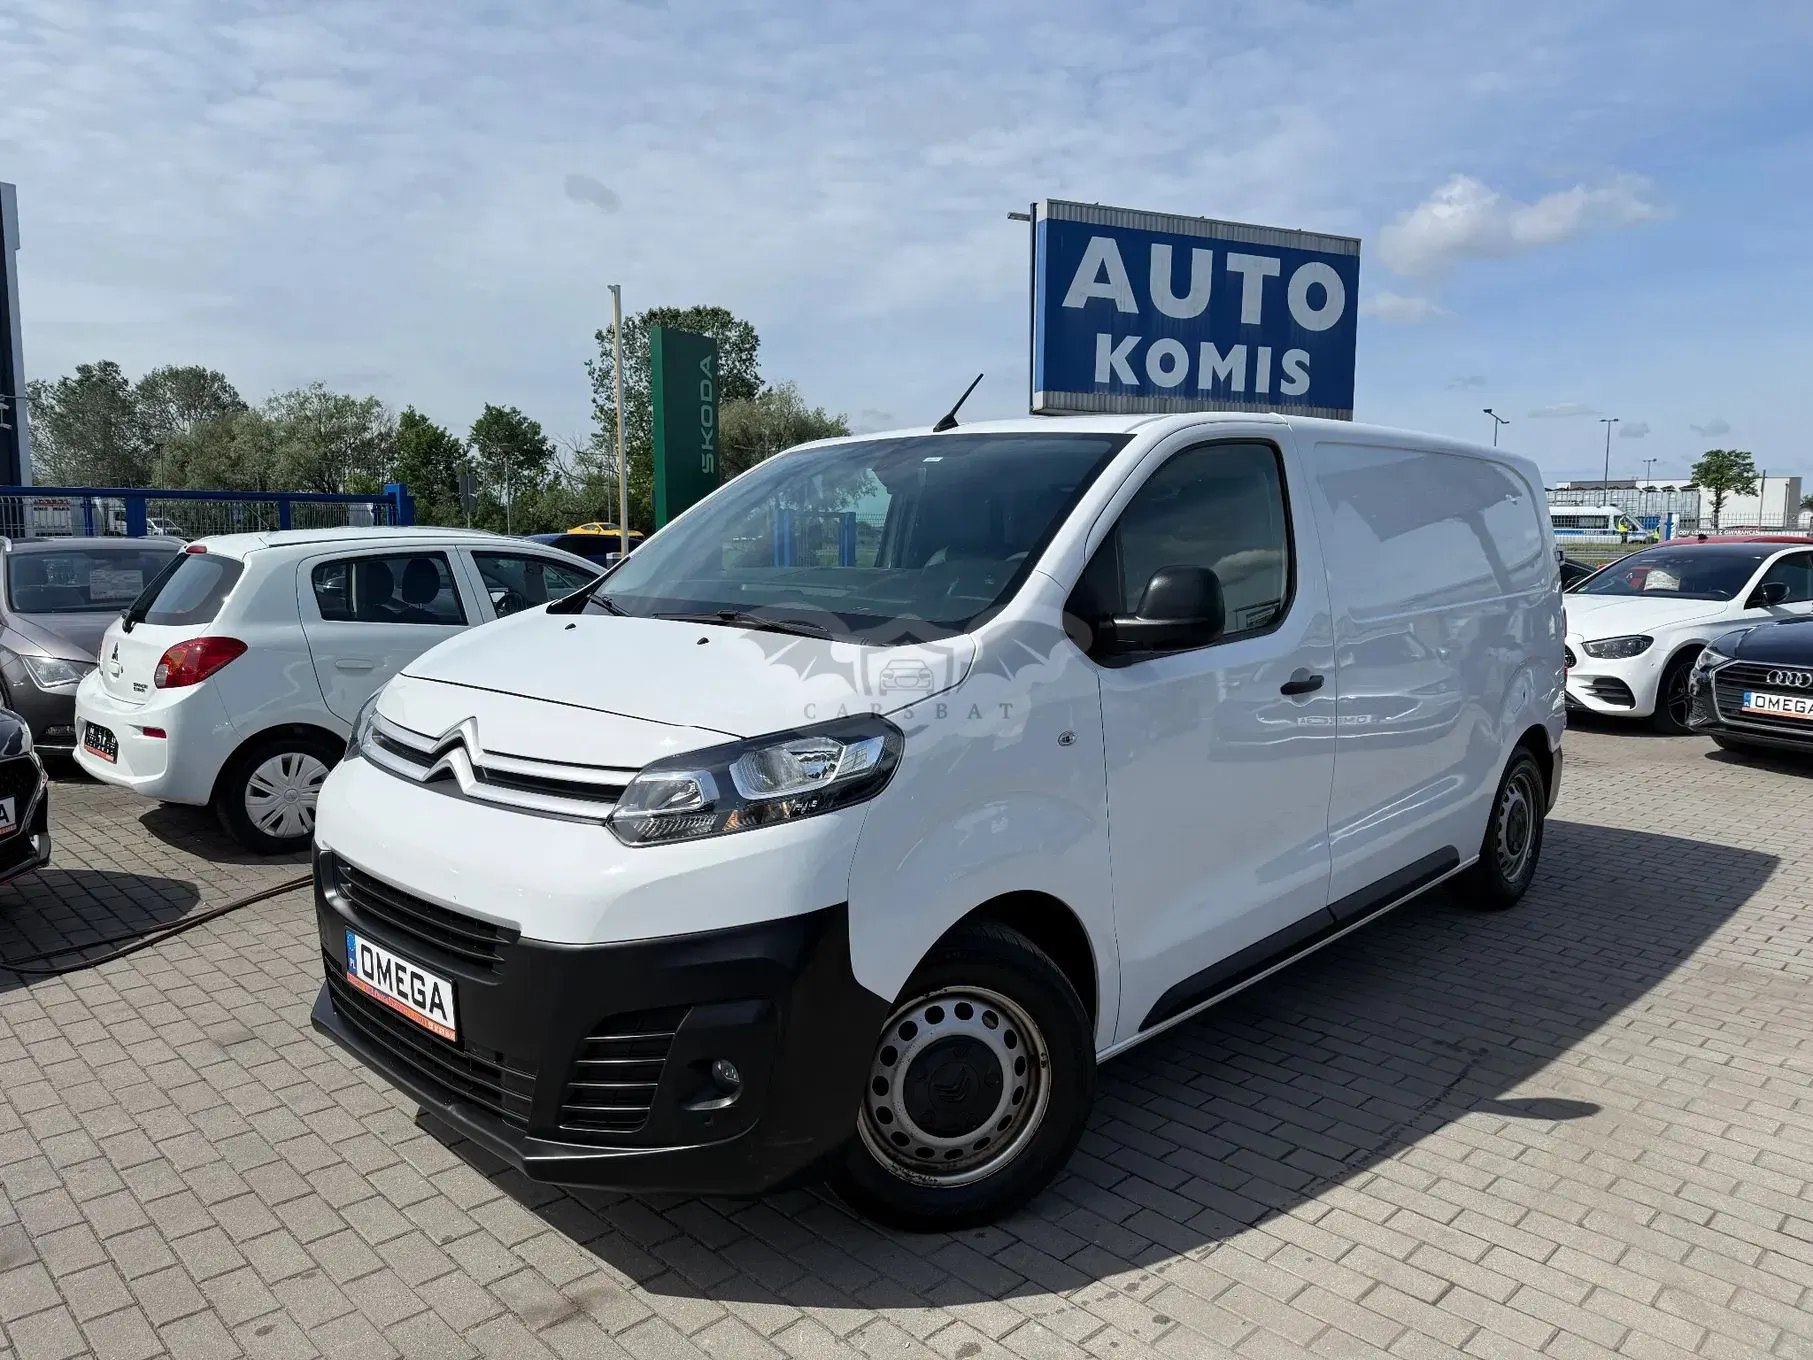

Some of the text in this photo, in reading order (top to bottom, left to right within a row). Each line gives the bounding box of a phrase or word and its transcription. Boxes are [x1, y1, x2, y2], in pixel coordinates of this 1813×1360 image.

[1061, 235, 1346, 332] AUTO
[1094, 332, 1311, 396] KOMIS
[360, 943, 448, 1022] OMEGA
